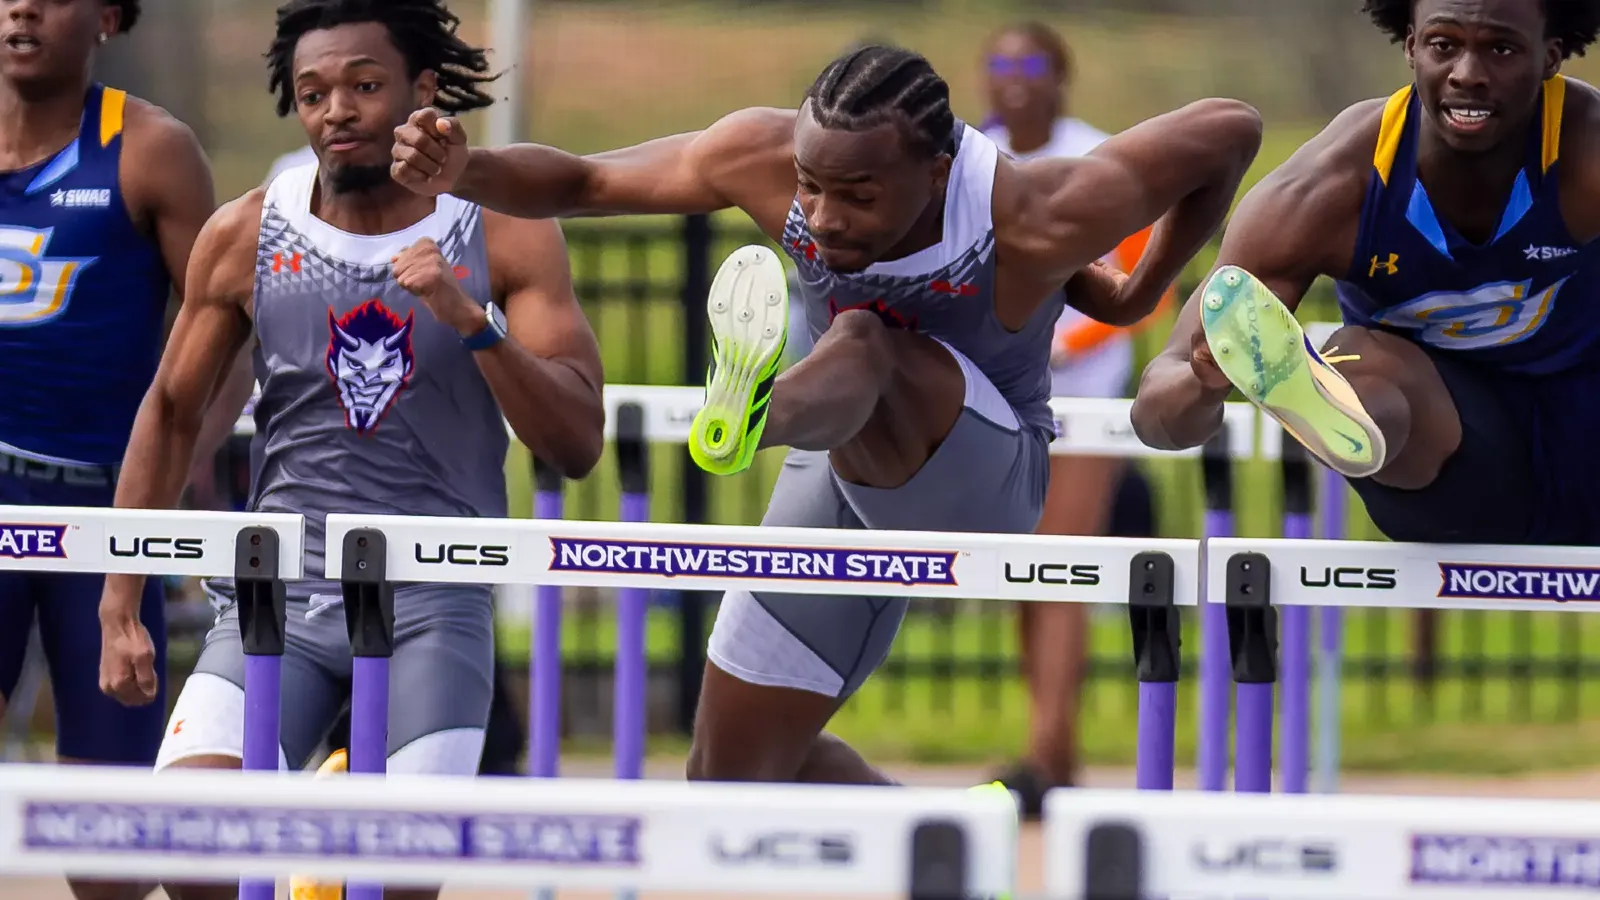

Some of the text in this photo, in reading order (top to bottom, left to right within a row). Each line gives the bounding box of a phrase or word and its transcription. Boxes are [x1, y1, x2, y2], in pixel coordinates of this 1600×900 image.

[65, 188, 111, 203] SWAC
[0, 528, 56, 554] ATE
[109, 536, 204, 559] UCS
[414, 542, 509, 566] UCS
[560, 543, 834, 576] NORTHWESTERN
[846, 553, 947, 581] STATE
[1004, 562, 1100, 586] UCS
[1300, 566, 1397, 589] UCS
[1450, 569, 1600, 598] NORTHW
[709, 829, 855, 866] UCS
[1192, 839, 1337, 872] UCS
